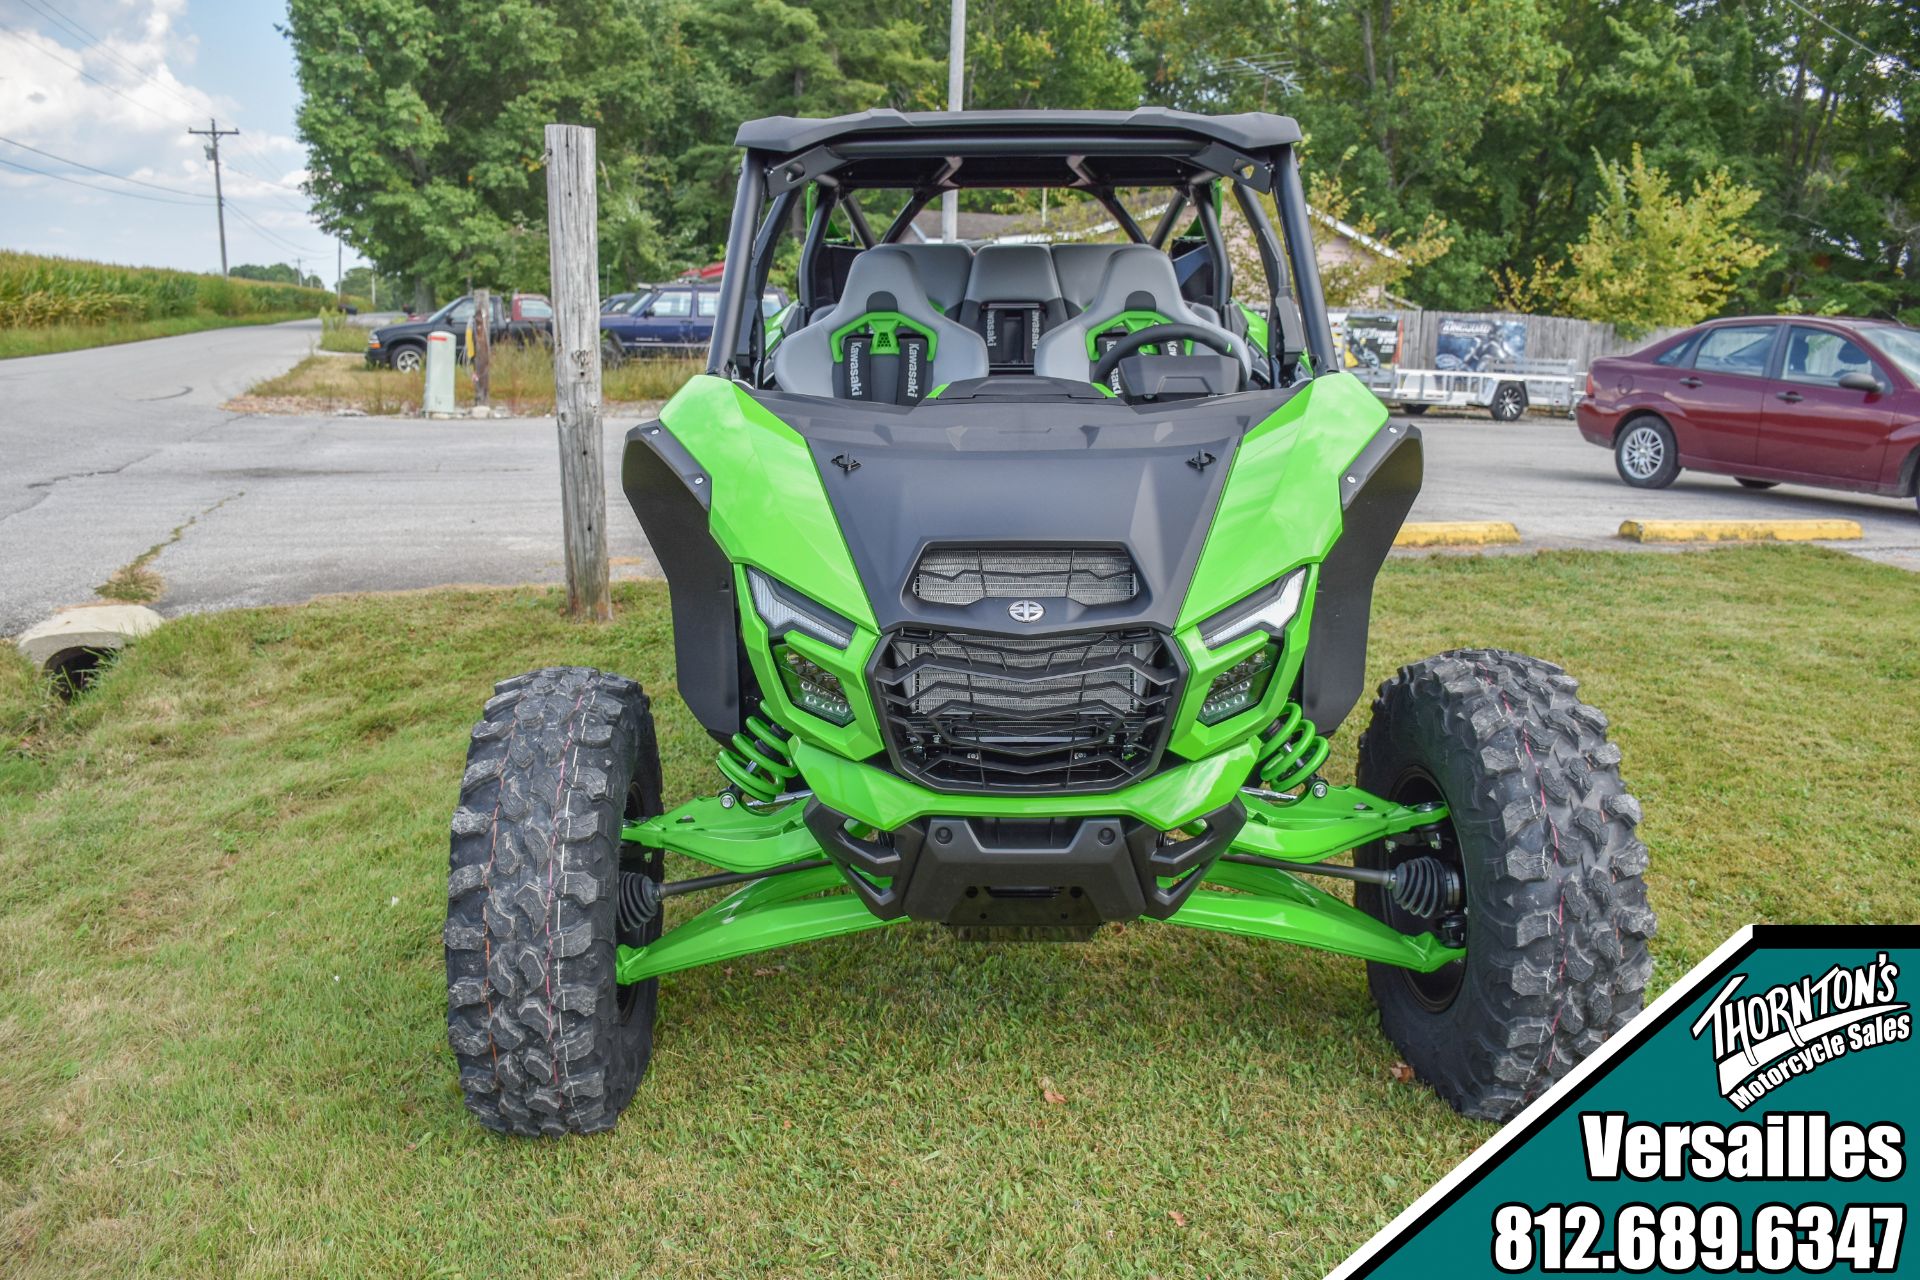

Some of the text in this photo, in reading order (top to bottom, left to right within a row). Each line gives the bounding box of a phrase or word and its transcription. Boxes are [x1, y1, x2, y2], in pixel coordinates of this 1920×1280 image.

[986, 309, 997, 347] wasaki
[850, 342, 862, 396] Kawasaki
[907, 343, 920, 398] Kawasaki
